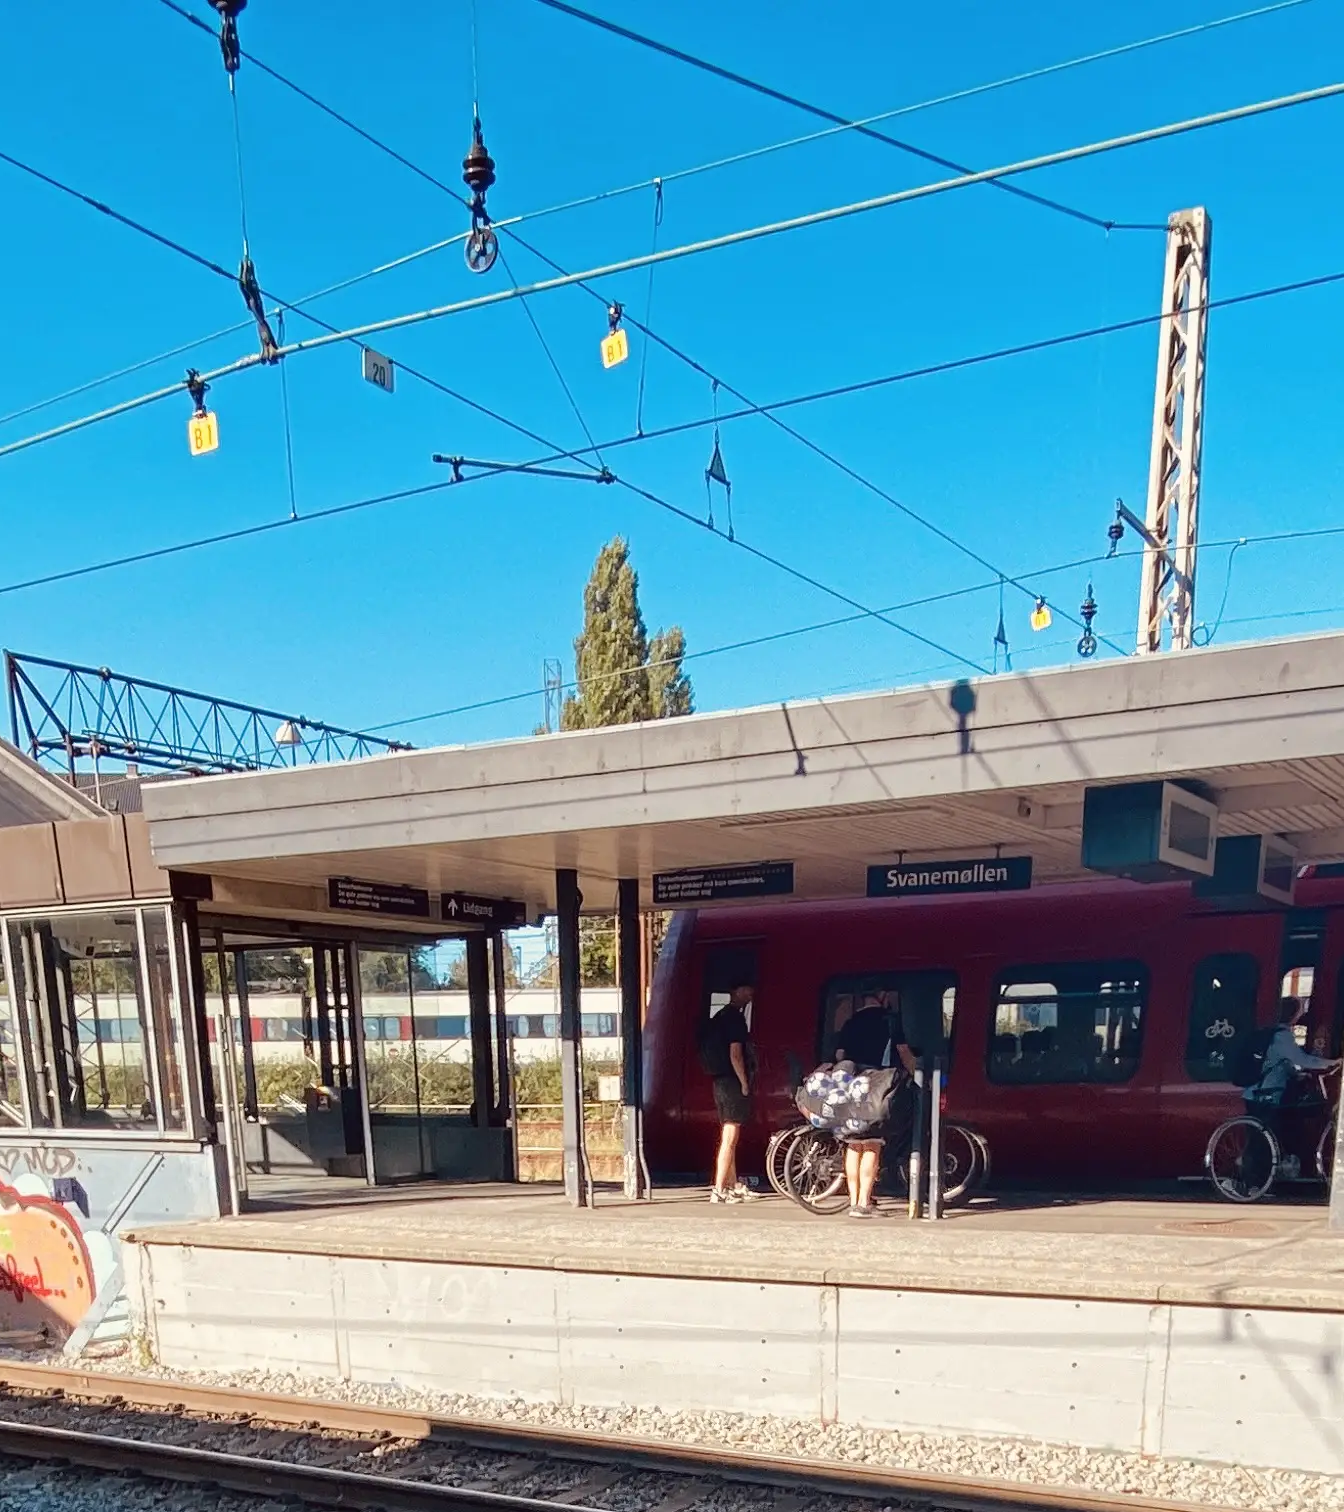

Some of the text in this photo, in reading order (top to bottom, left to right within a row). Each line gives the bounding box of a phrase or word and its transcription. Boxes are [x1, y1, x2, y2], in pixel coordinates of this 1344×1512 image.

[373, 362, 386, 387] 20
[194, 424, 213, 450] B1
[886, 864, 1009, 889] Svanemøllen
